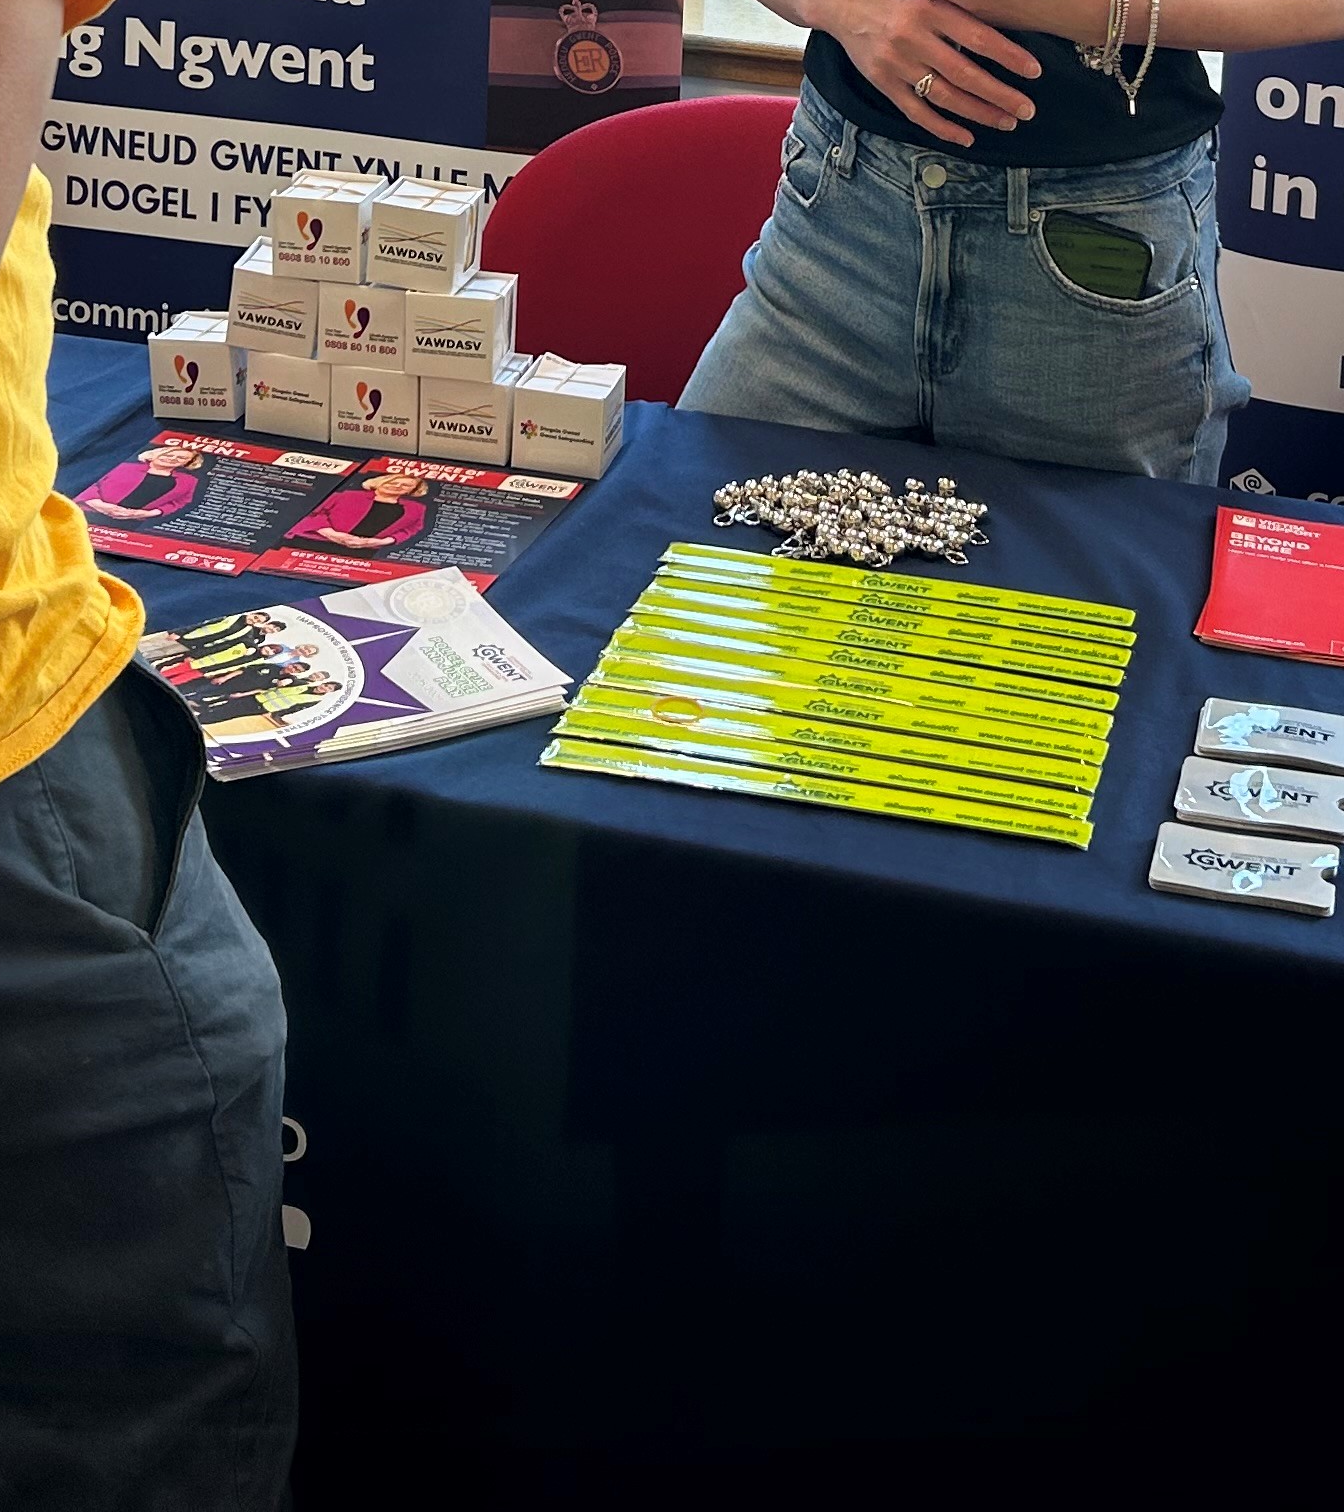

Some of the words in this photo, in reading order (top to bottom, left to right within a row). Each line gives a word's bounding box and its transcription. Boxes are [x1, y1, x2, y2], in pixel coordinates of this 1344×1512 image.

[125, 17, 375, 92] Ngwent
[41, 120, 197, 165] GWNEUD
[211, 140, 342, 181] GWENT
[1251, 155, 1318, 220] in
[66, 175, 196, 220] DIOGEL
[210, 195, 218, 222] I
[305, 255, 316, 263] 80
[319, 256, 330, 264] 10
[333, 258, 350, 266] 800
[379, 244, 443, 263] VAWDASV
[238, 310, 302, 331] VAWDASV
[351, 343, 362, 351] 80
[365, 344, 376, 352] 10
[379, 346, 396, 354] 800
[415, 336, 481, 351] VAWDASV
[198, 398, 207, 406] 10
[377, 426, 388, 436] 10
[429, 419, 493, 436] VAWDASV
[164, 438, 251, 458] GWENT
[386, 466, 475, 483] GWENT
[387, 458, 418, 467] THE
[420, 463, 459, 473] VOICE
[462, 467, 486, 476] OF
[1229, 539, 1292, 555] CRIME
[1230, 532, 1310, 550] BEYOND
[868, 577, 933, 593] GWENT
[858, 612, 923, 630] GWENT
[482, 648, 527, 682] GWENT
[838, 652, 904, 671] GWENT
[815, 703, 885, 721] GWENT
[1196, 854, 1302, 877] GWENT
